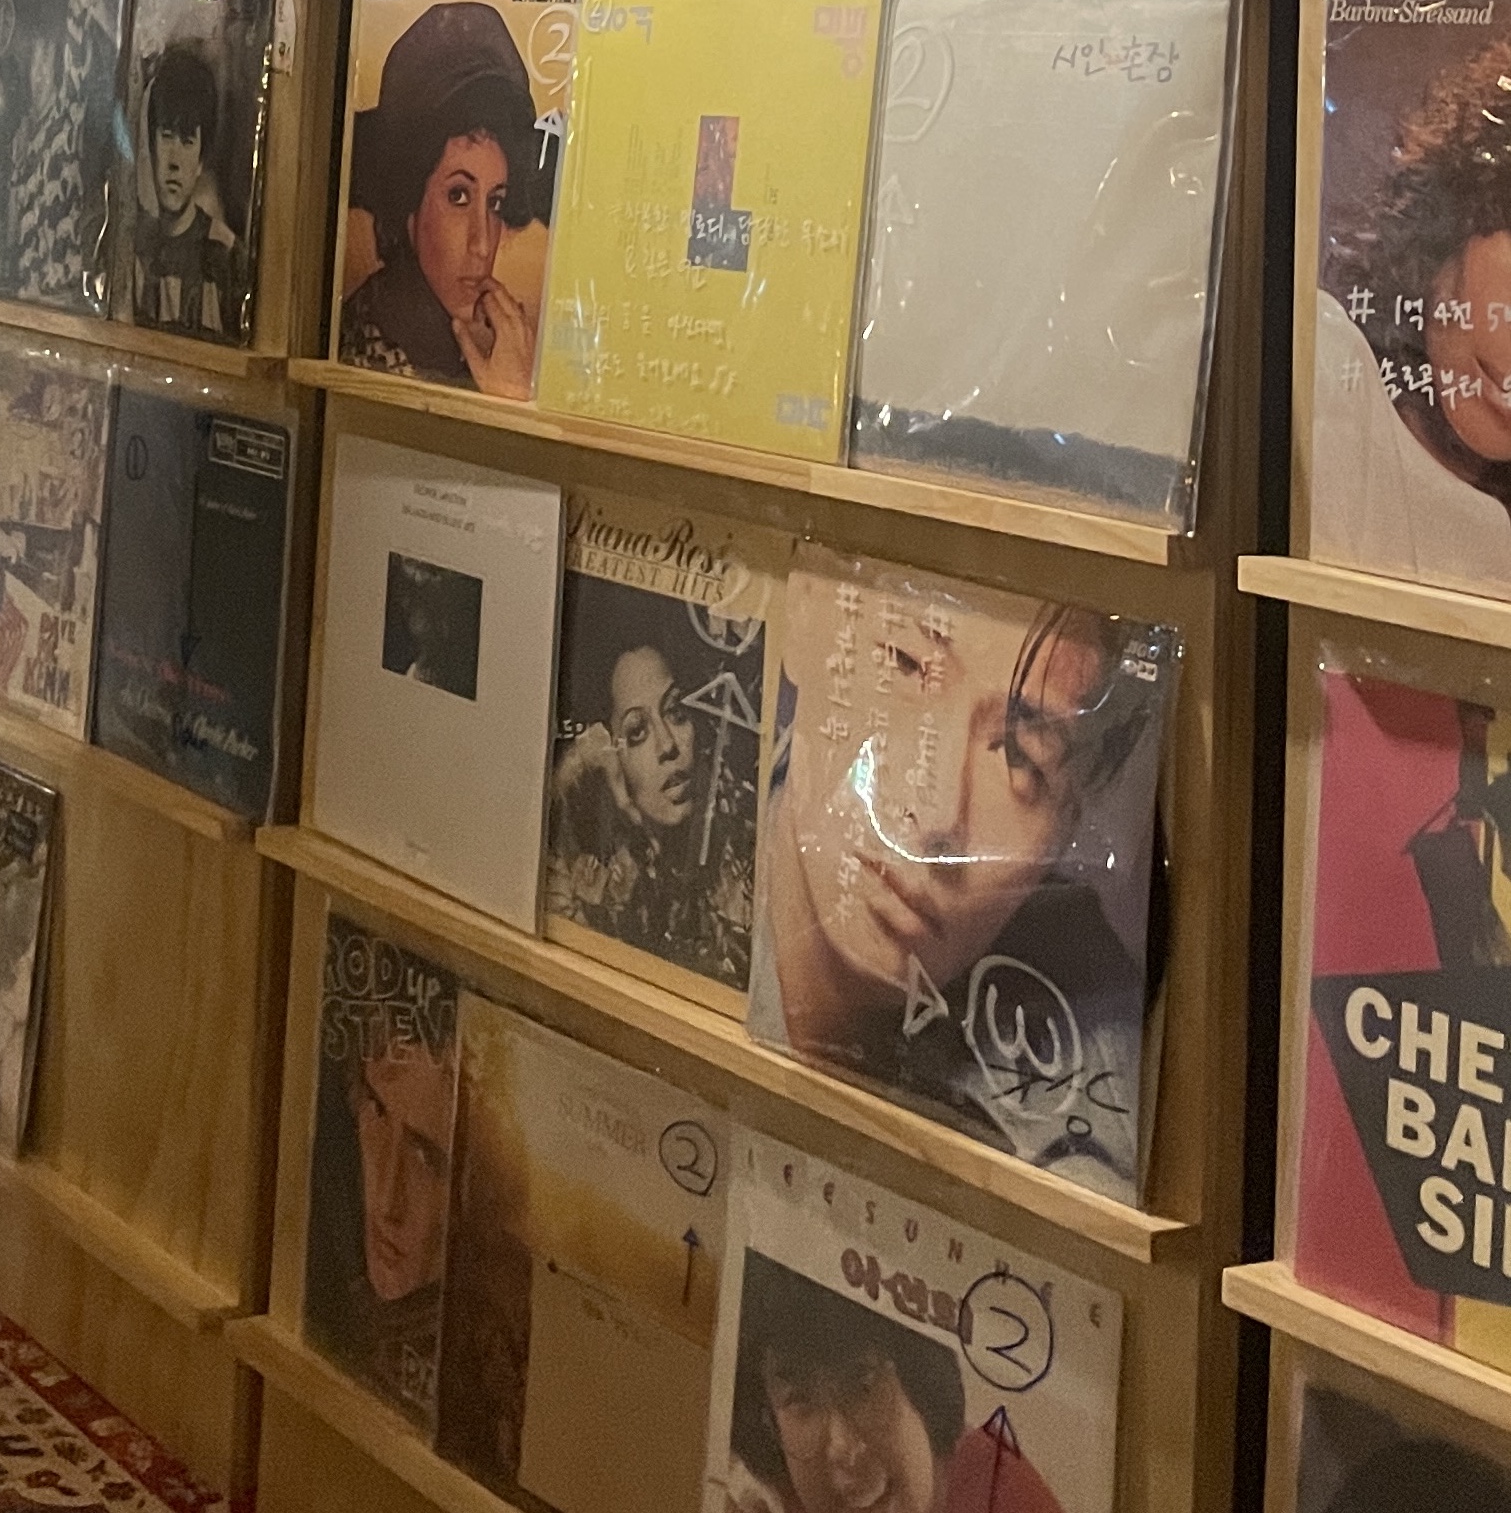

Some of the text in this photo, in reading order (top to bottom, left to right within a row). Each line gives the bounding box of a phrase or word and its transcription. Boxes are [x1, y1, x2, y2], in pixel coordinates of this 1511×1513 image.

[572, 546, 662, 589] REATEST
[1344, 986, 1511, 1104] CHE
[1386, 1077, 1511, 1194] BA
[1414, 1174, 1511, 1279] SI
